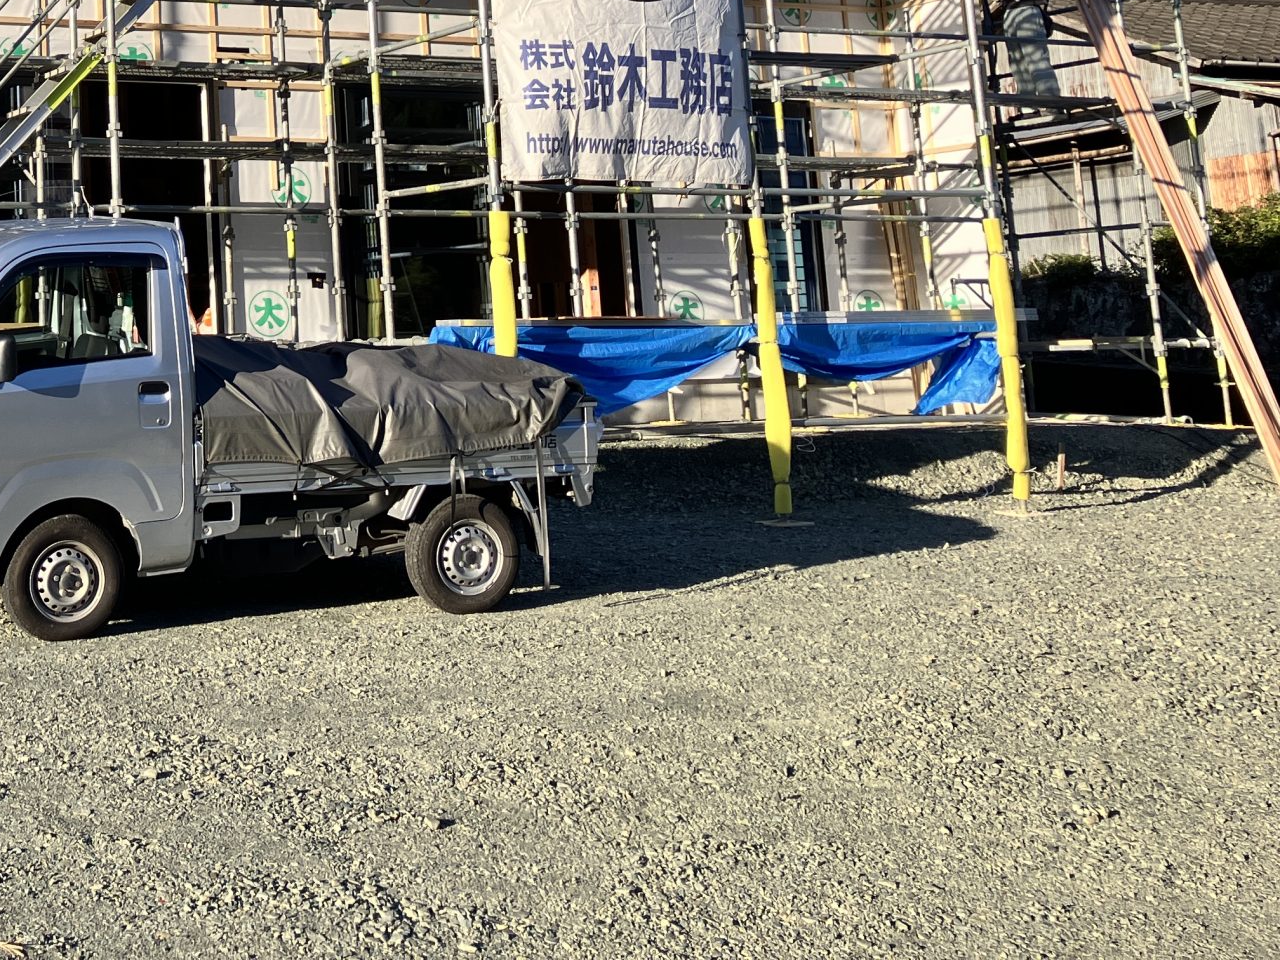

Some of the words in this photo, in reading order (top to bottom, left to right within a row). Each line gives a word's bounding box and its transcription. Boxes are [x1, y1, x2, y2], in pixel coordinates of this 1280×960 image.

[520, 39, 576, 71] 株式
[582, 41, 734, 118] 鈴木工務店
[522, 78, 577, 111] 会社
